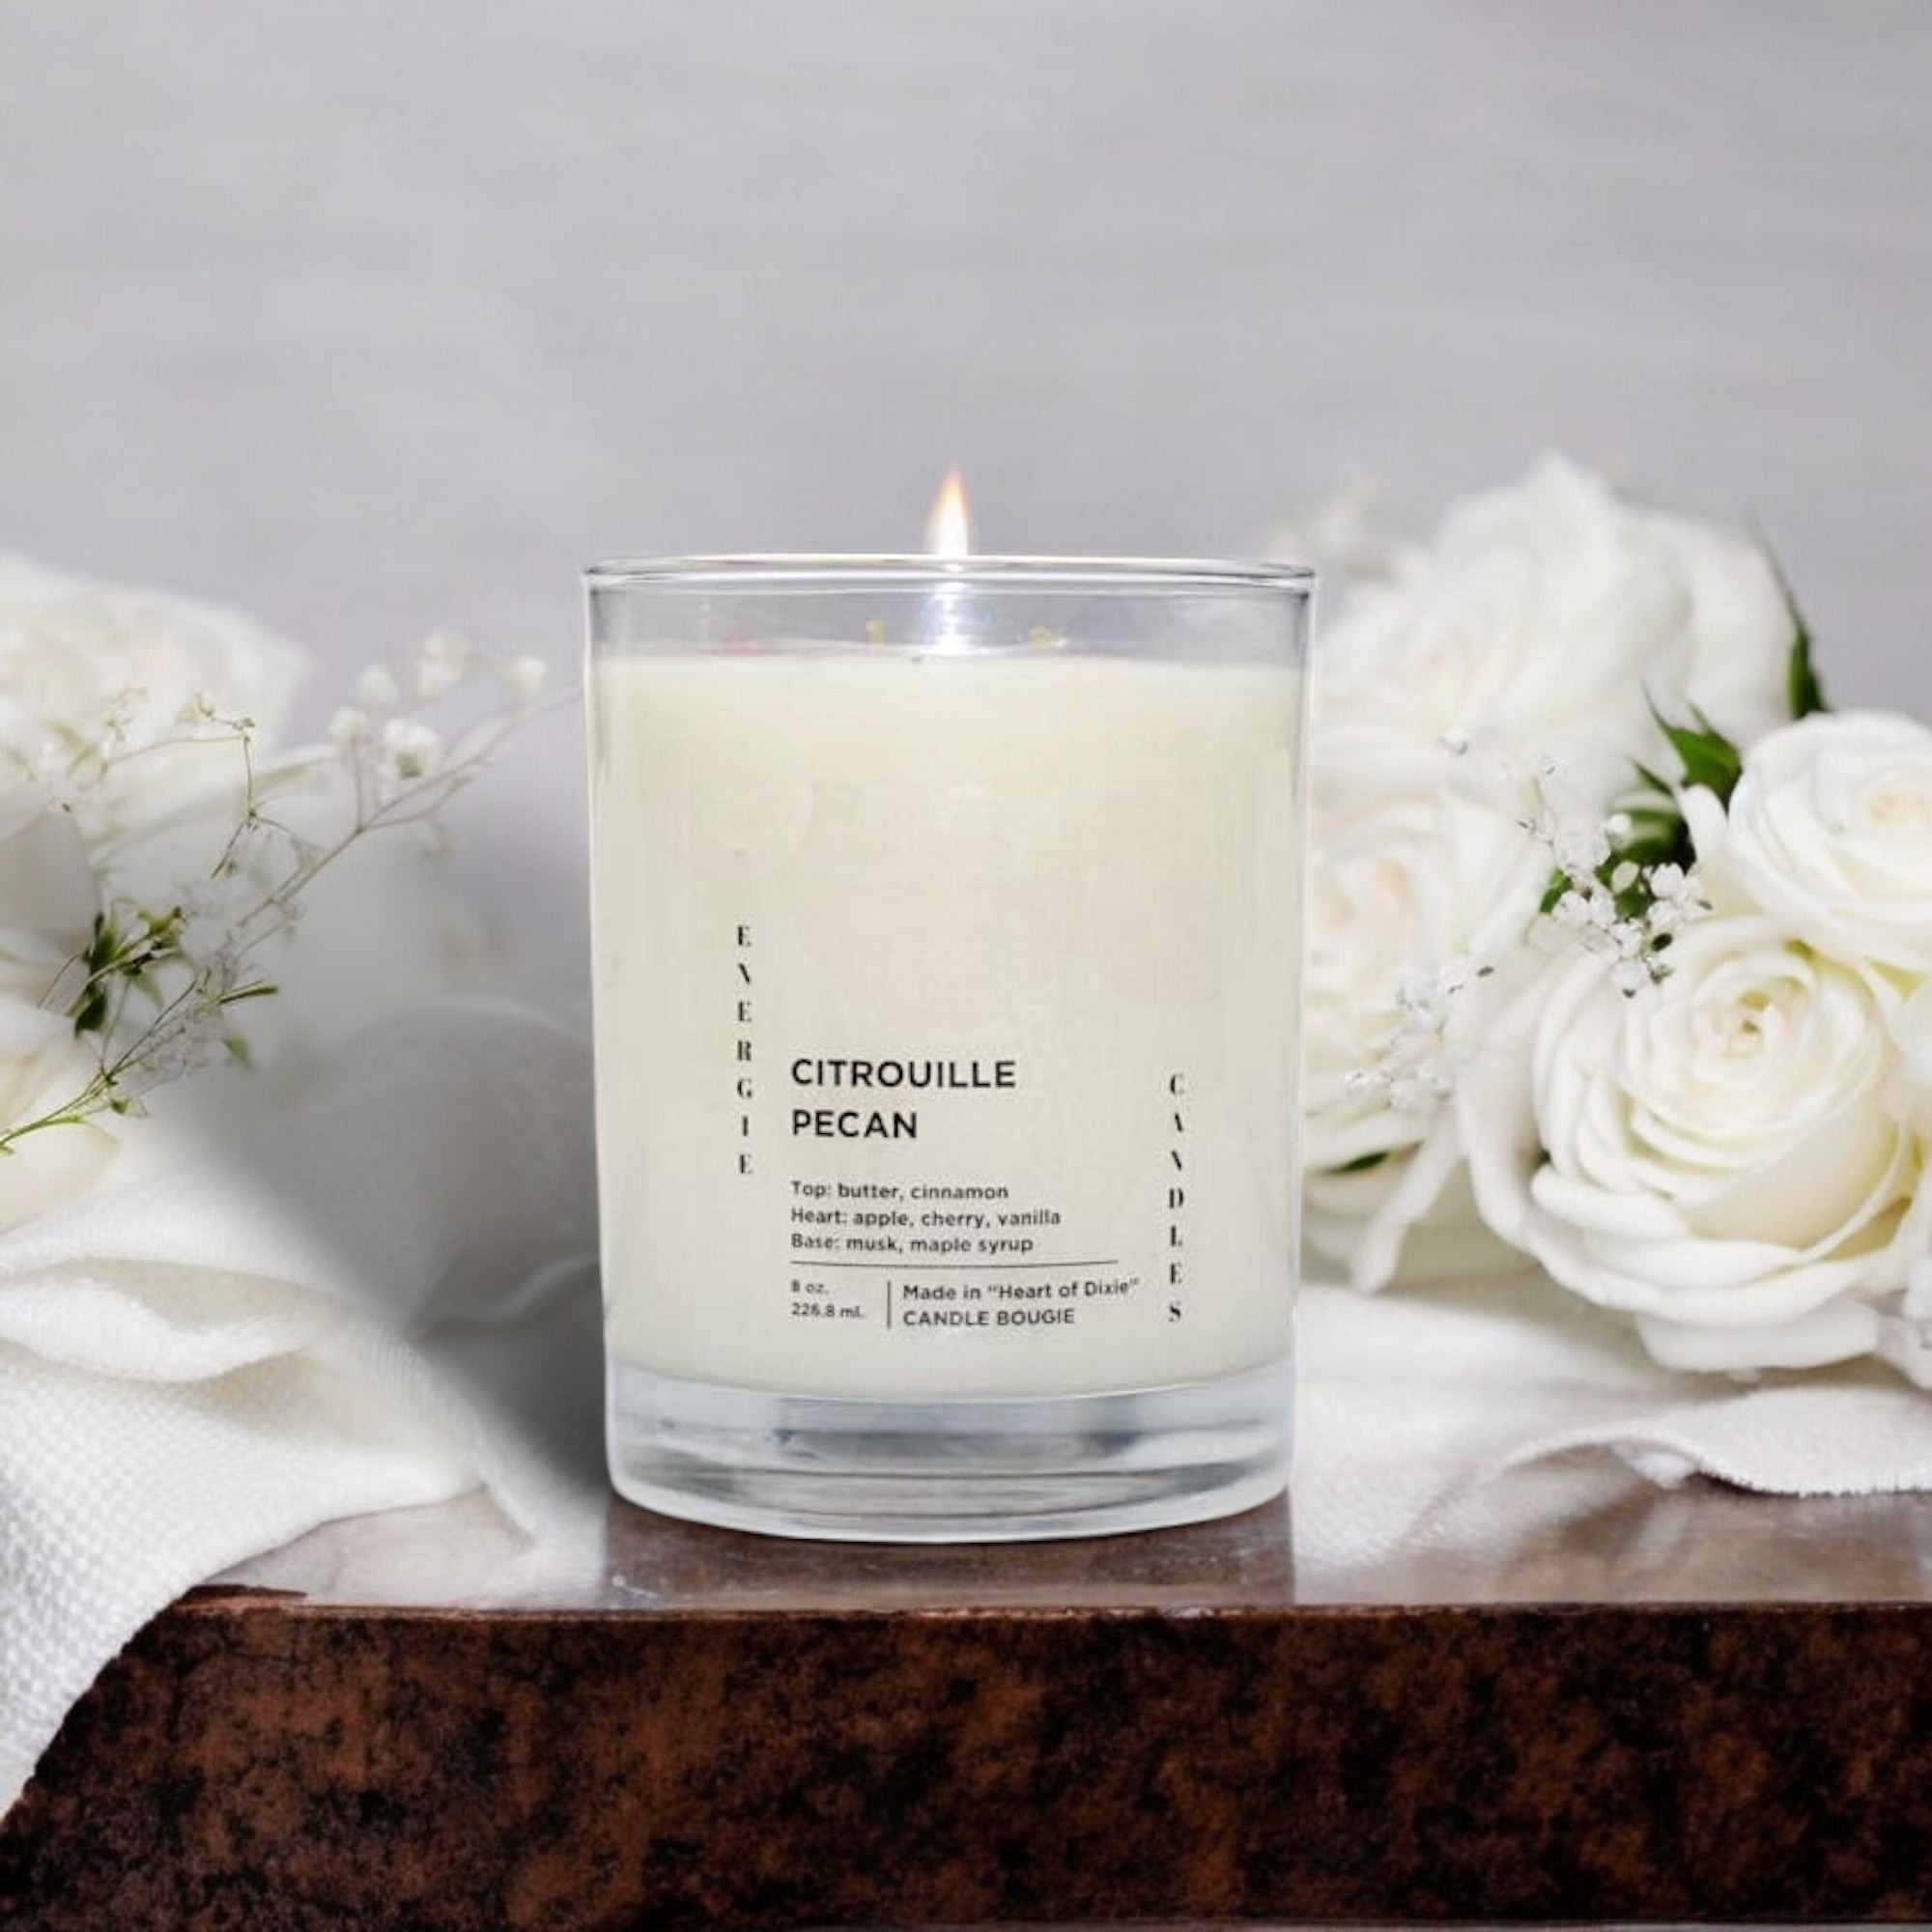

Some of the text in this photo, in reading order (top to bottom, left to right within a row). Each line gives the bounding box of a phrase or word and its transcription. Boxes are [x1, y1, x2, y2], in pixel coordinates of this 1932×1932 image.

[736, 924, 753, 1176] ENERGIE
[790, 1057, 1017, 1090] CITROUILLE
[791, 1108, 918, 1140] PECAN
[791, 1180, 1009, 1202] Top: butter, cinnamon
[1169, 1072, 1186, 1323] CANDLES
[790, 1208, 1062, 1229] Heart: apple, cherry, vanilla
[790, 1233, 1034, 1256] Base: musk, maple syrup
[790, 1279, 801, 1293] 8
[902, 1277, 1140, 1301] Made in “Heart of Dixie”
[790, 1301, 836, 1319] 226.8
[902, 1307, 1076, 1327] CANDLE BOUGIE
